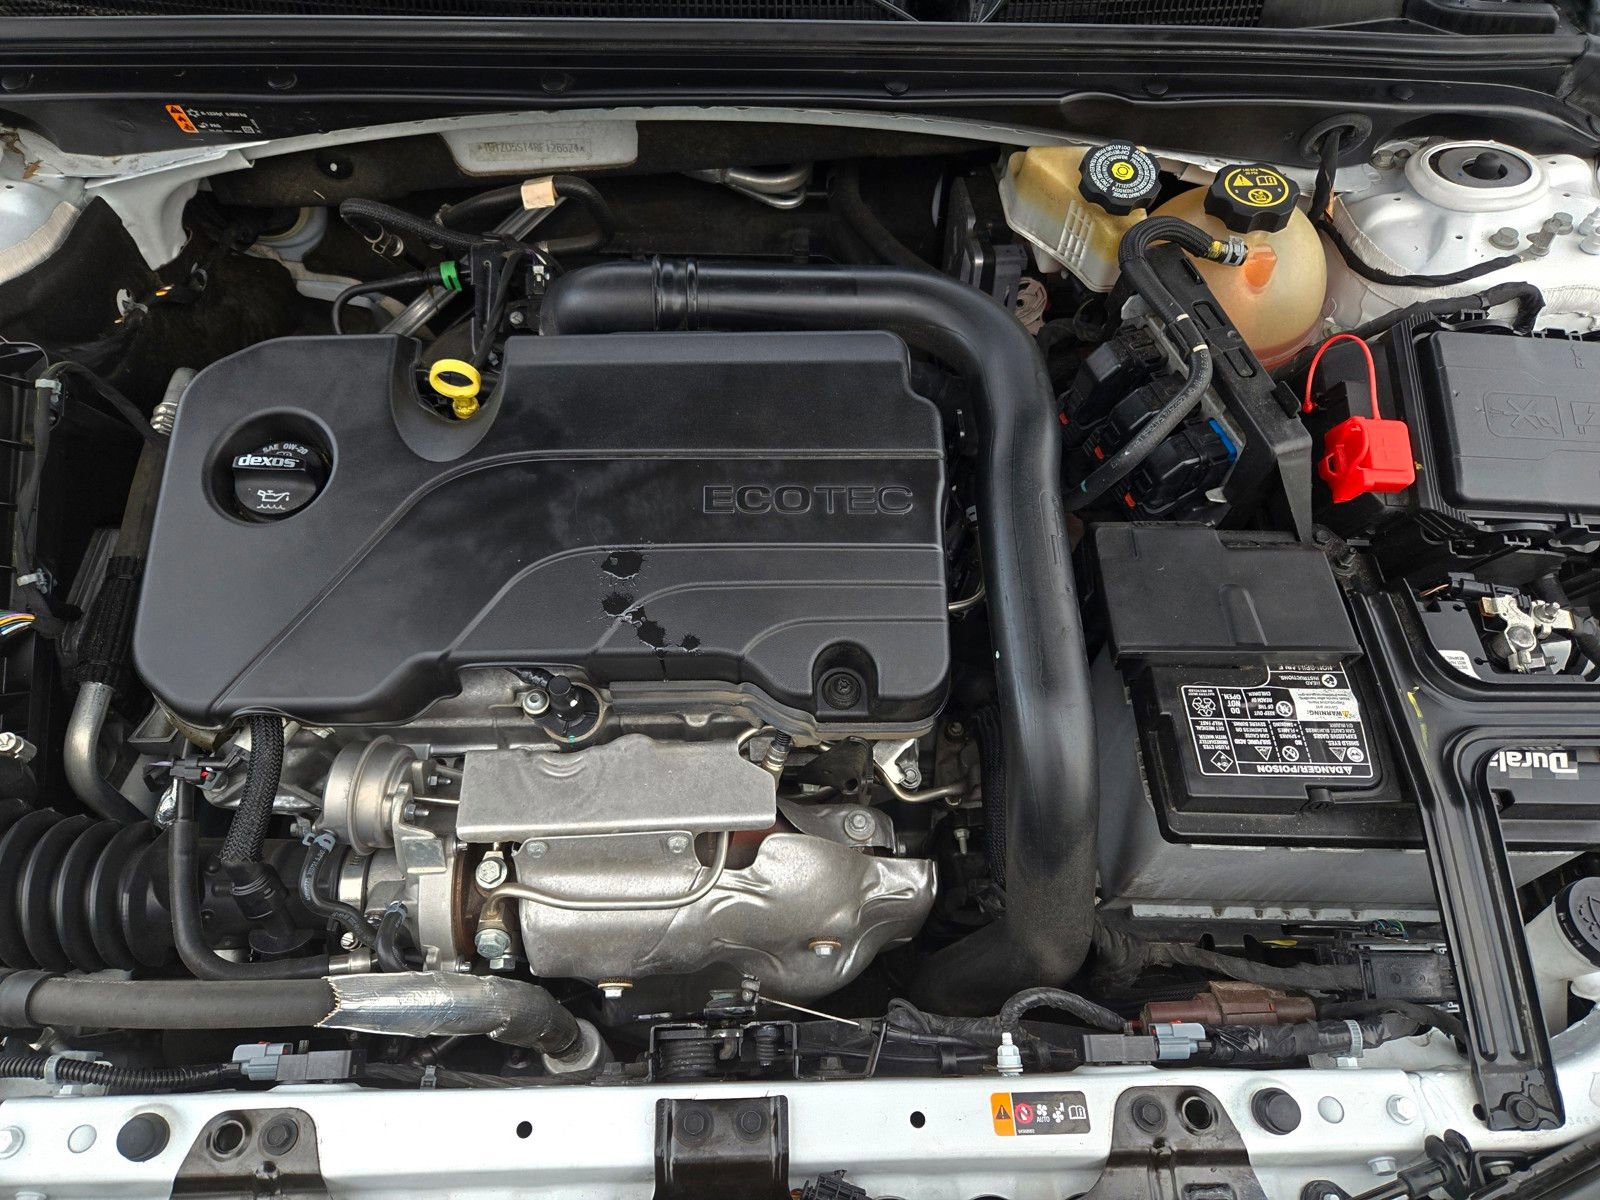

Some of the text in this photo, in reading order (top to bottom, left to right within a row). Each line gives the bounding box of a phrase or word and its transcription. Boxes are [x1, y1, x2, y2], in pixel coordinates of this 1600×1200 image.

[262, 443, 309, 455] SAE 0W-20
[238, 454, 296, 468] dexos
[703, 485, 913, 515] ECOTEC
[1256, 765, 1344, 774] DANGER/POISON
